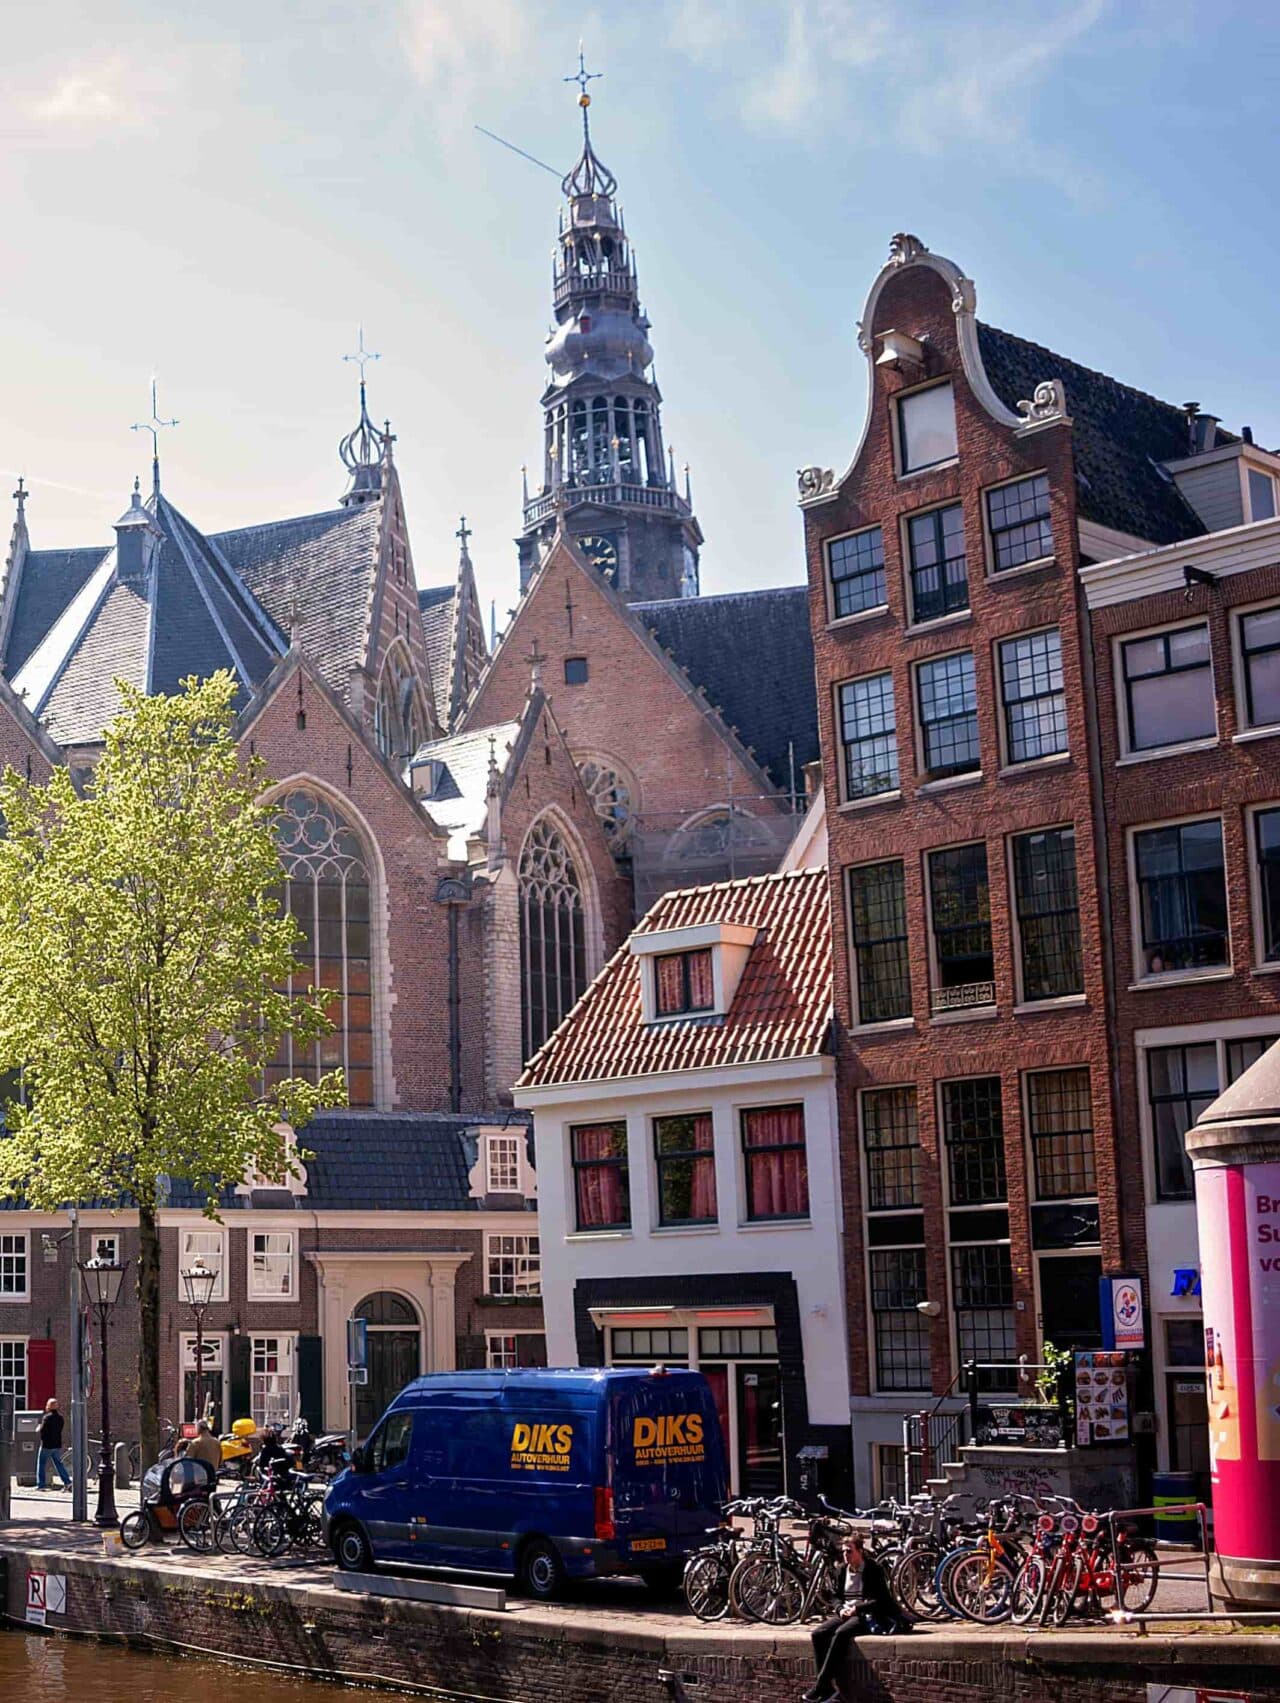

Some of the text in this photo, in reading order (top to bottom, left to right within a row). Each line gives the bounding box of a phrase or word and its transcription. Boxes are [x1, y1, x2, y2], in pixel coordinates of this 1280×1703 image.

[511, 1423, 573, 1454] DIKS
[633, 1414, 704, 1448] DIKS
[511, 1452, 570, 1465] AUTOVERHUUR
[635, 1444, 704, 1459] AUTOVERHUUR
